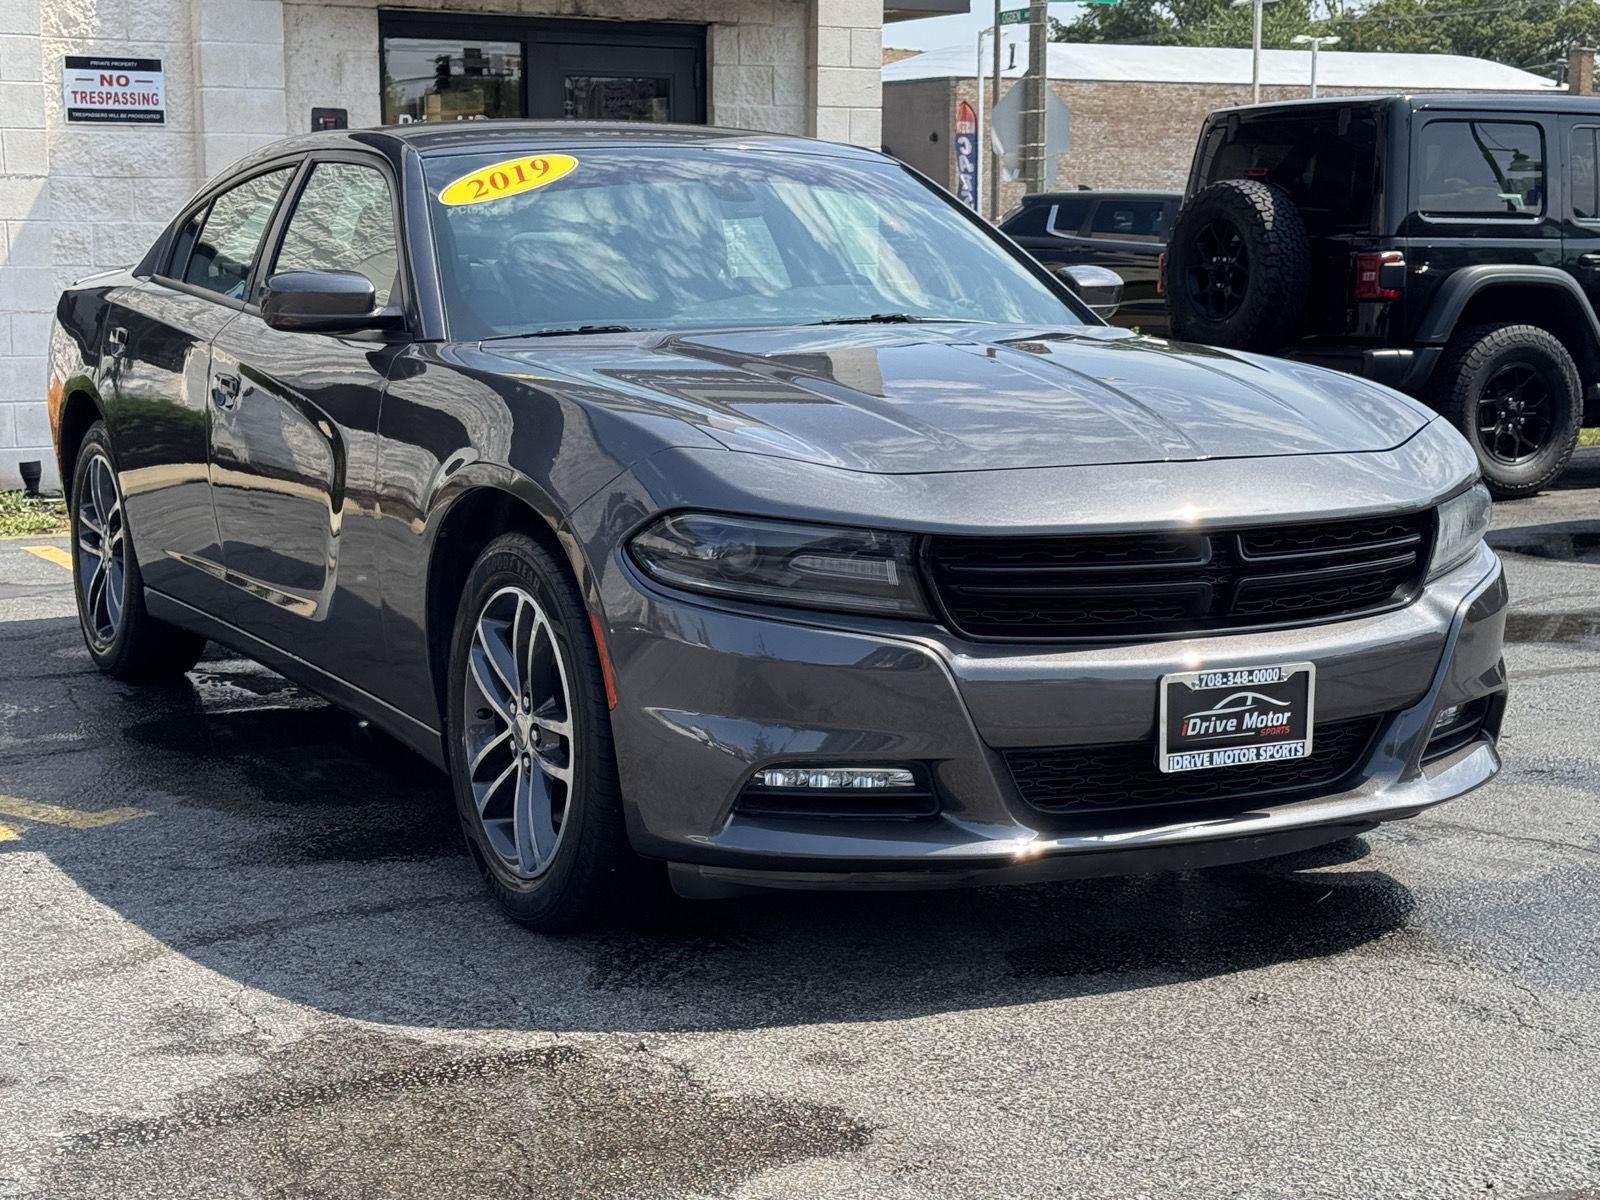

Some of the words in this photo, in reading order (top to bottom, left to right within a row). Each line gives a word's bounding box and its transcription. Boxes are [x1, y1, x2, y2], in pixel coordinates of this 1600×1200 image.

[100, 74, 130, 87] NO
[71, 91, 159, 106] TRESPASSING
[467, 158, 550, 199] 2019
[1200, 668, 1280, 688] 708-348-0000
[1181, 716, 1237, 737] iDrive
[1242, 711, 1291, 730] Motor
[1260, 726, 1291, 737] SPORTS
[1213, 748, 1257, 766] MOTOR
[1259, 743, 1304, 760] SPORTS
